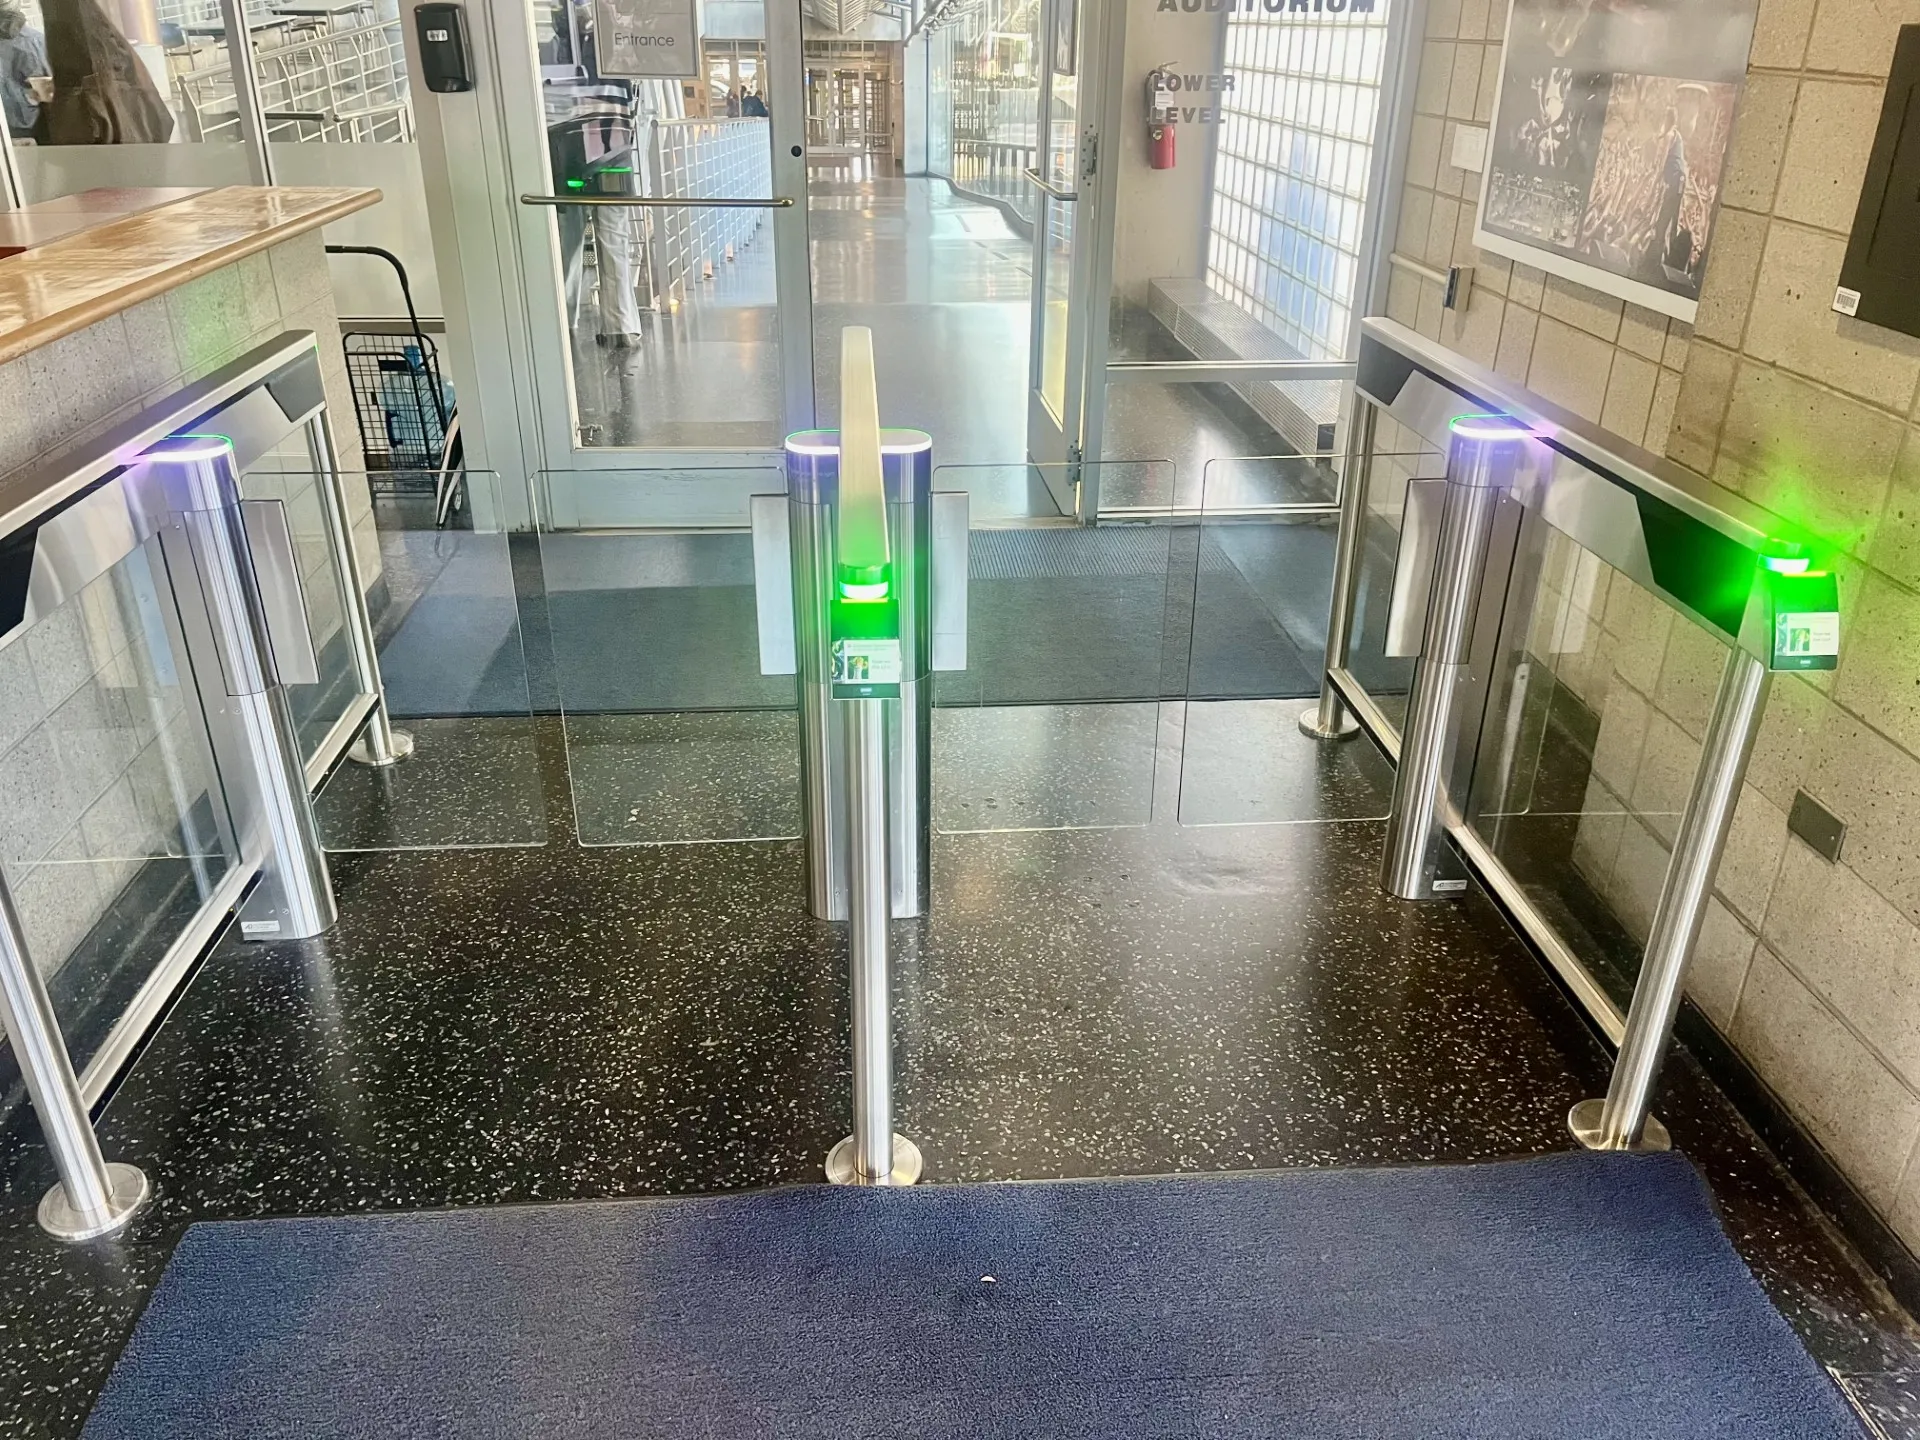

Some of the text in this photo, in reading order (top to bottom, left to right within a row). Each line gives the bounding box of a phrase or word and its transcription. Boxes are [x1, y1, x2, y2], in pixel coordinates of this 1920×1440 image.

[615, 32, 674, 46] Entrance
[1153, 74, 1235, 92] LOWER
[1151, 106, 1226, 124] LEVEL
